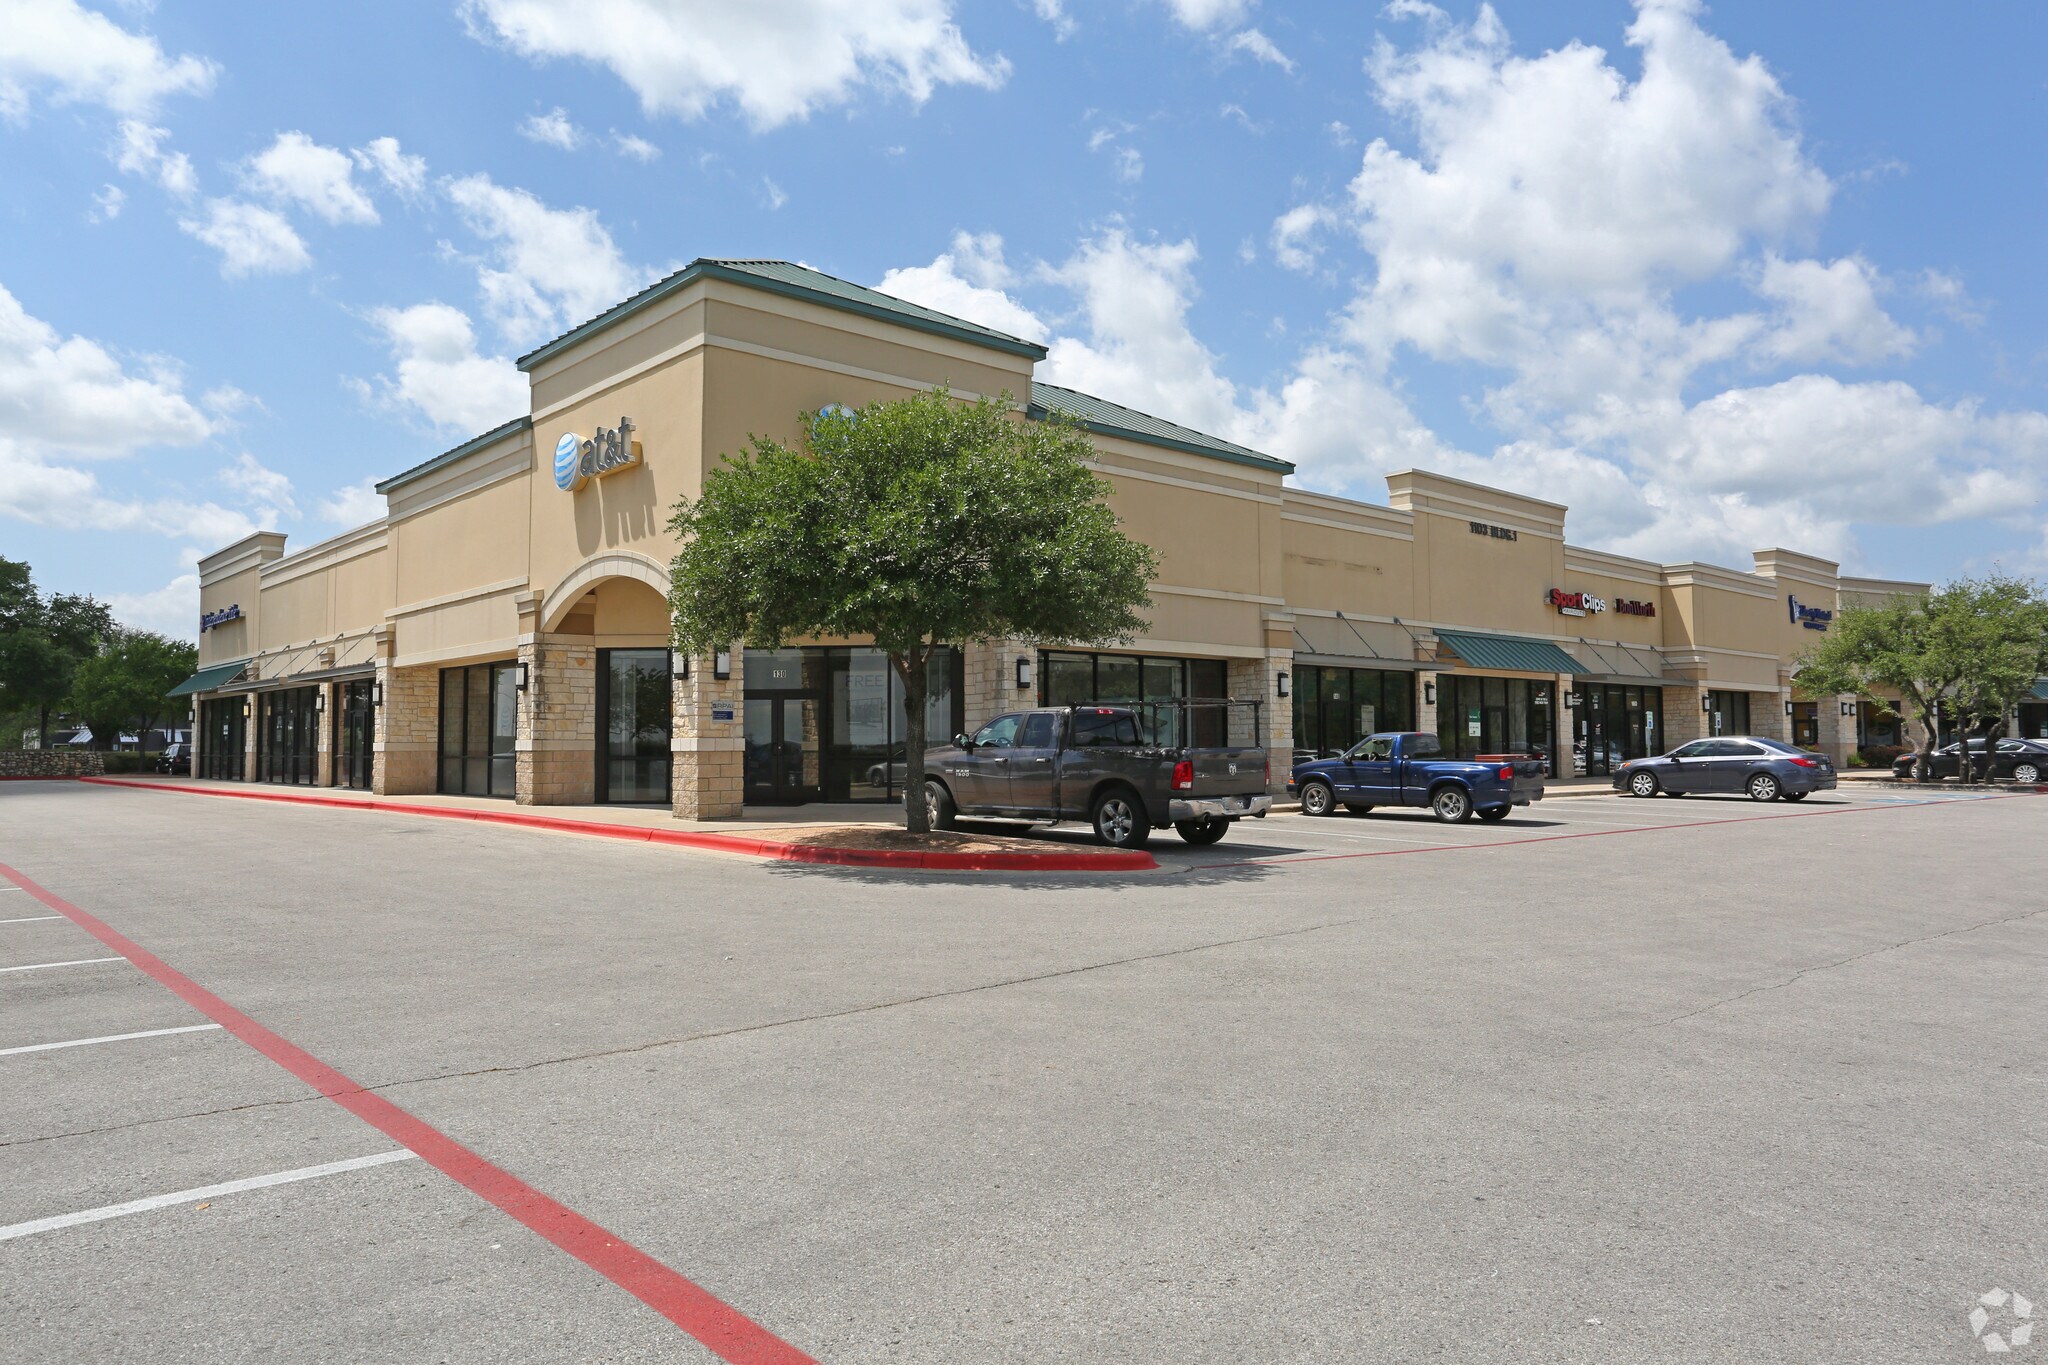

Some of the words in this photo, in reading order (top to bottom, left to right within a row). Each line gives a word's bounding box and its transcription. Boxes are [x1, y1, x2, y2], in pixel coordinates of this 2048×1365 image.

[580, 416, 636, 477] at&t
[774, 670, 786, 678] 130
[845, 674, 884, 687] FREE
